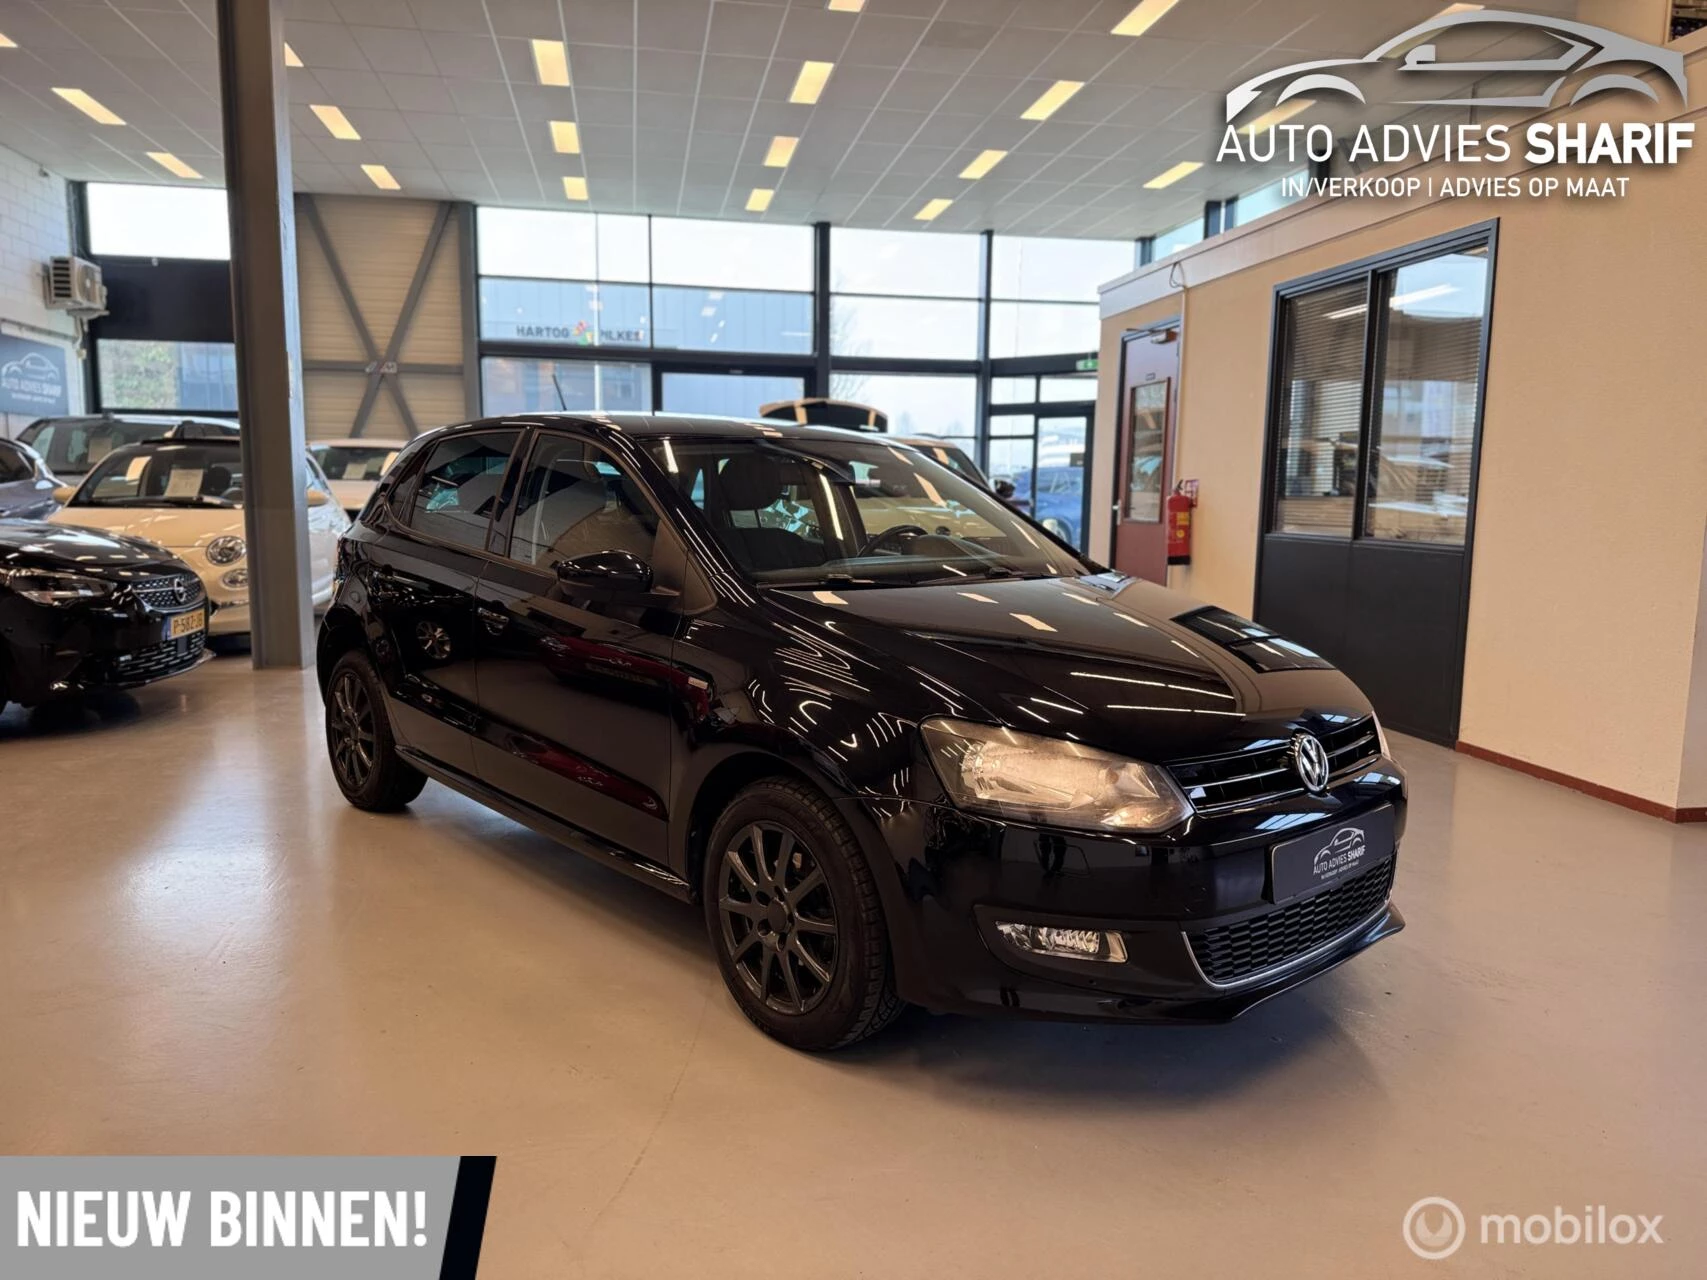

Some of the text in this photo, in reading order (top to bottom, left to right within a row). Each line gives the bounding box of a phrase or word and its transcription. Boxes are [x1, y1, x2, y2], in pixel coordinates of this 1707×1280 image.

[516, 325, 570, 338] HARTOG
[1313, 861, 1328, 875] AUTO
[1328, 853, 1347, 869] ADVIES
